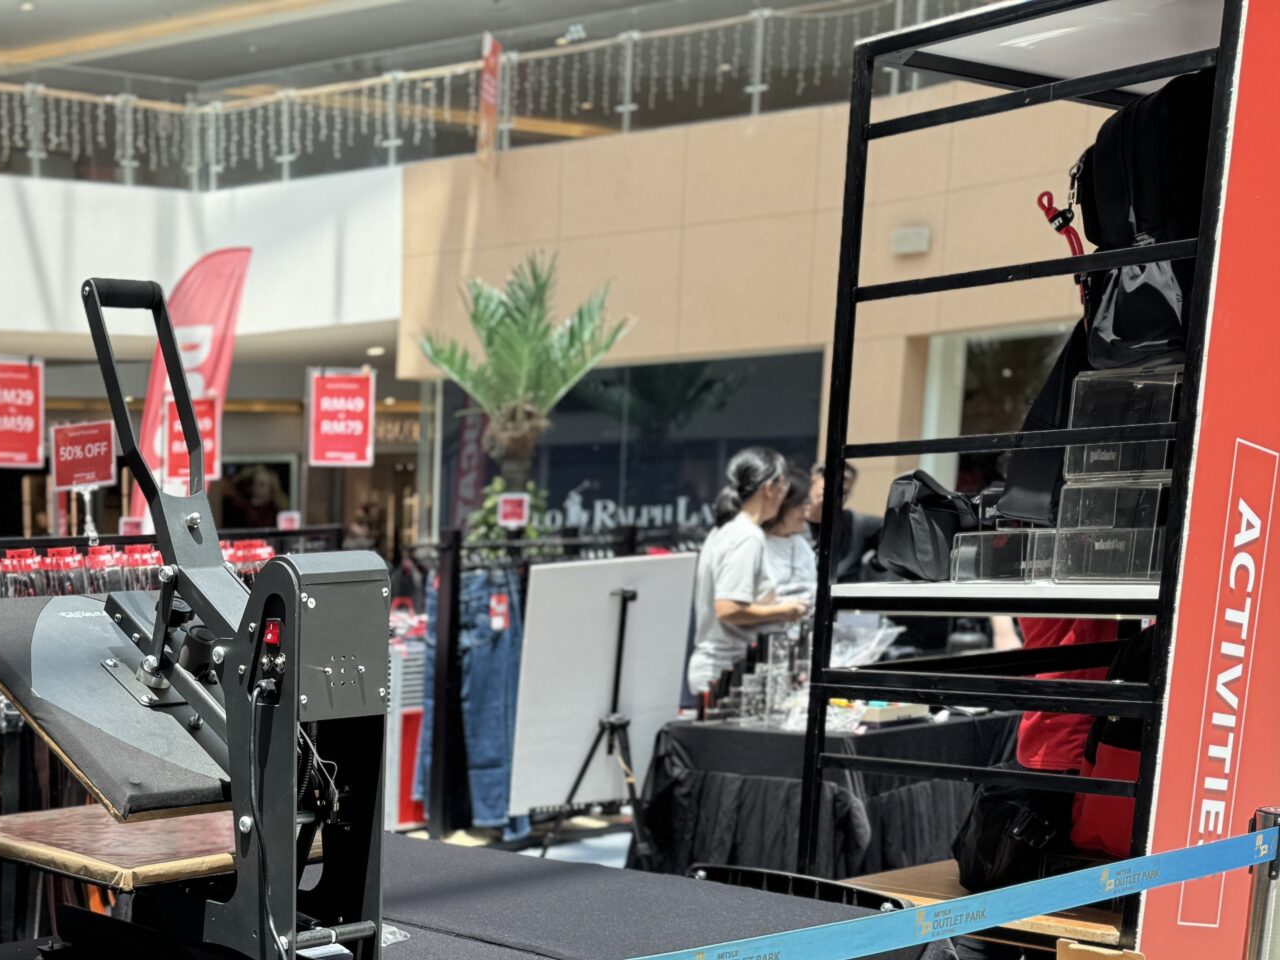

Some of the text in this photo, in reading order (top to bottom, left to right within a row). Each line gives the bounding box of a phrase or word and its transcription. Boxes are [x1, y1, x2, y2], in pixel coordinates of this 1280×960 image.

[60, 442, 108, 461] 50% OFF
[1197, 497, 1261, 846] ACTIVITIE
[1114, 868, 1160, 887] OUTLET PARK
[933, 909, 986, 929] OUTLET PARK
